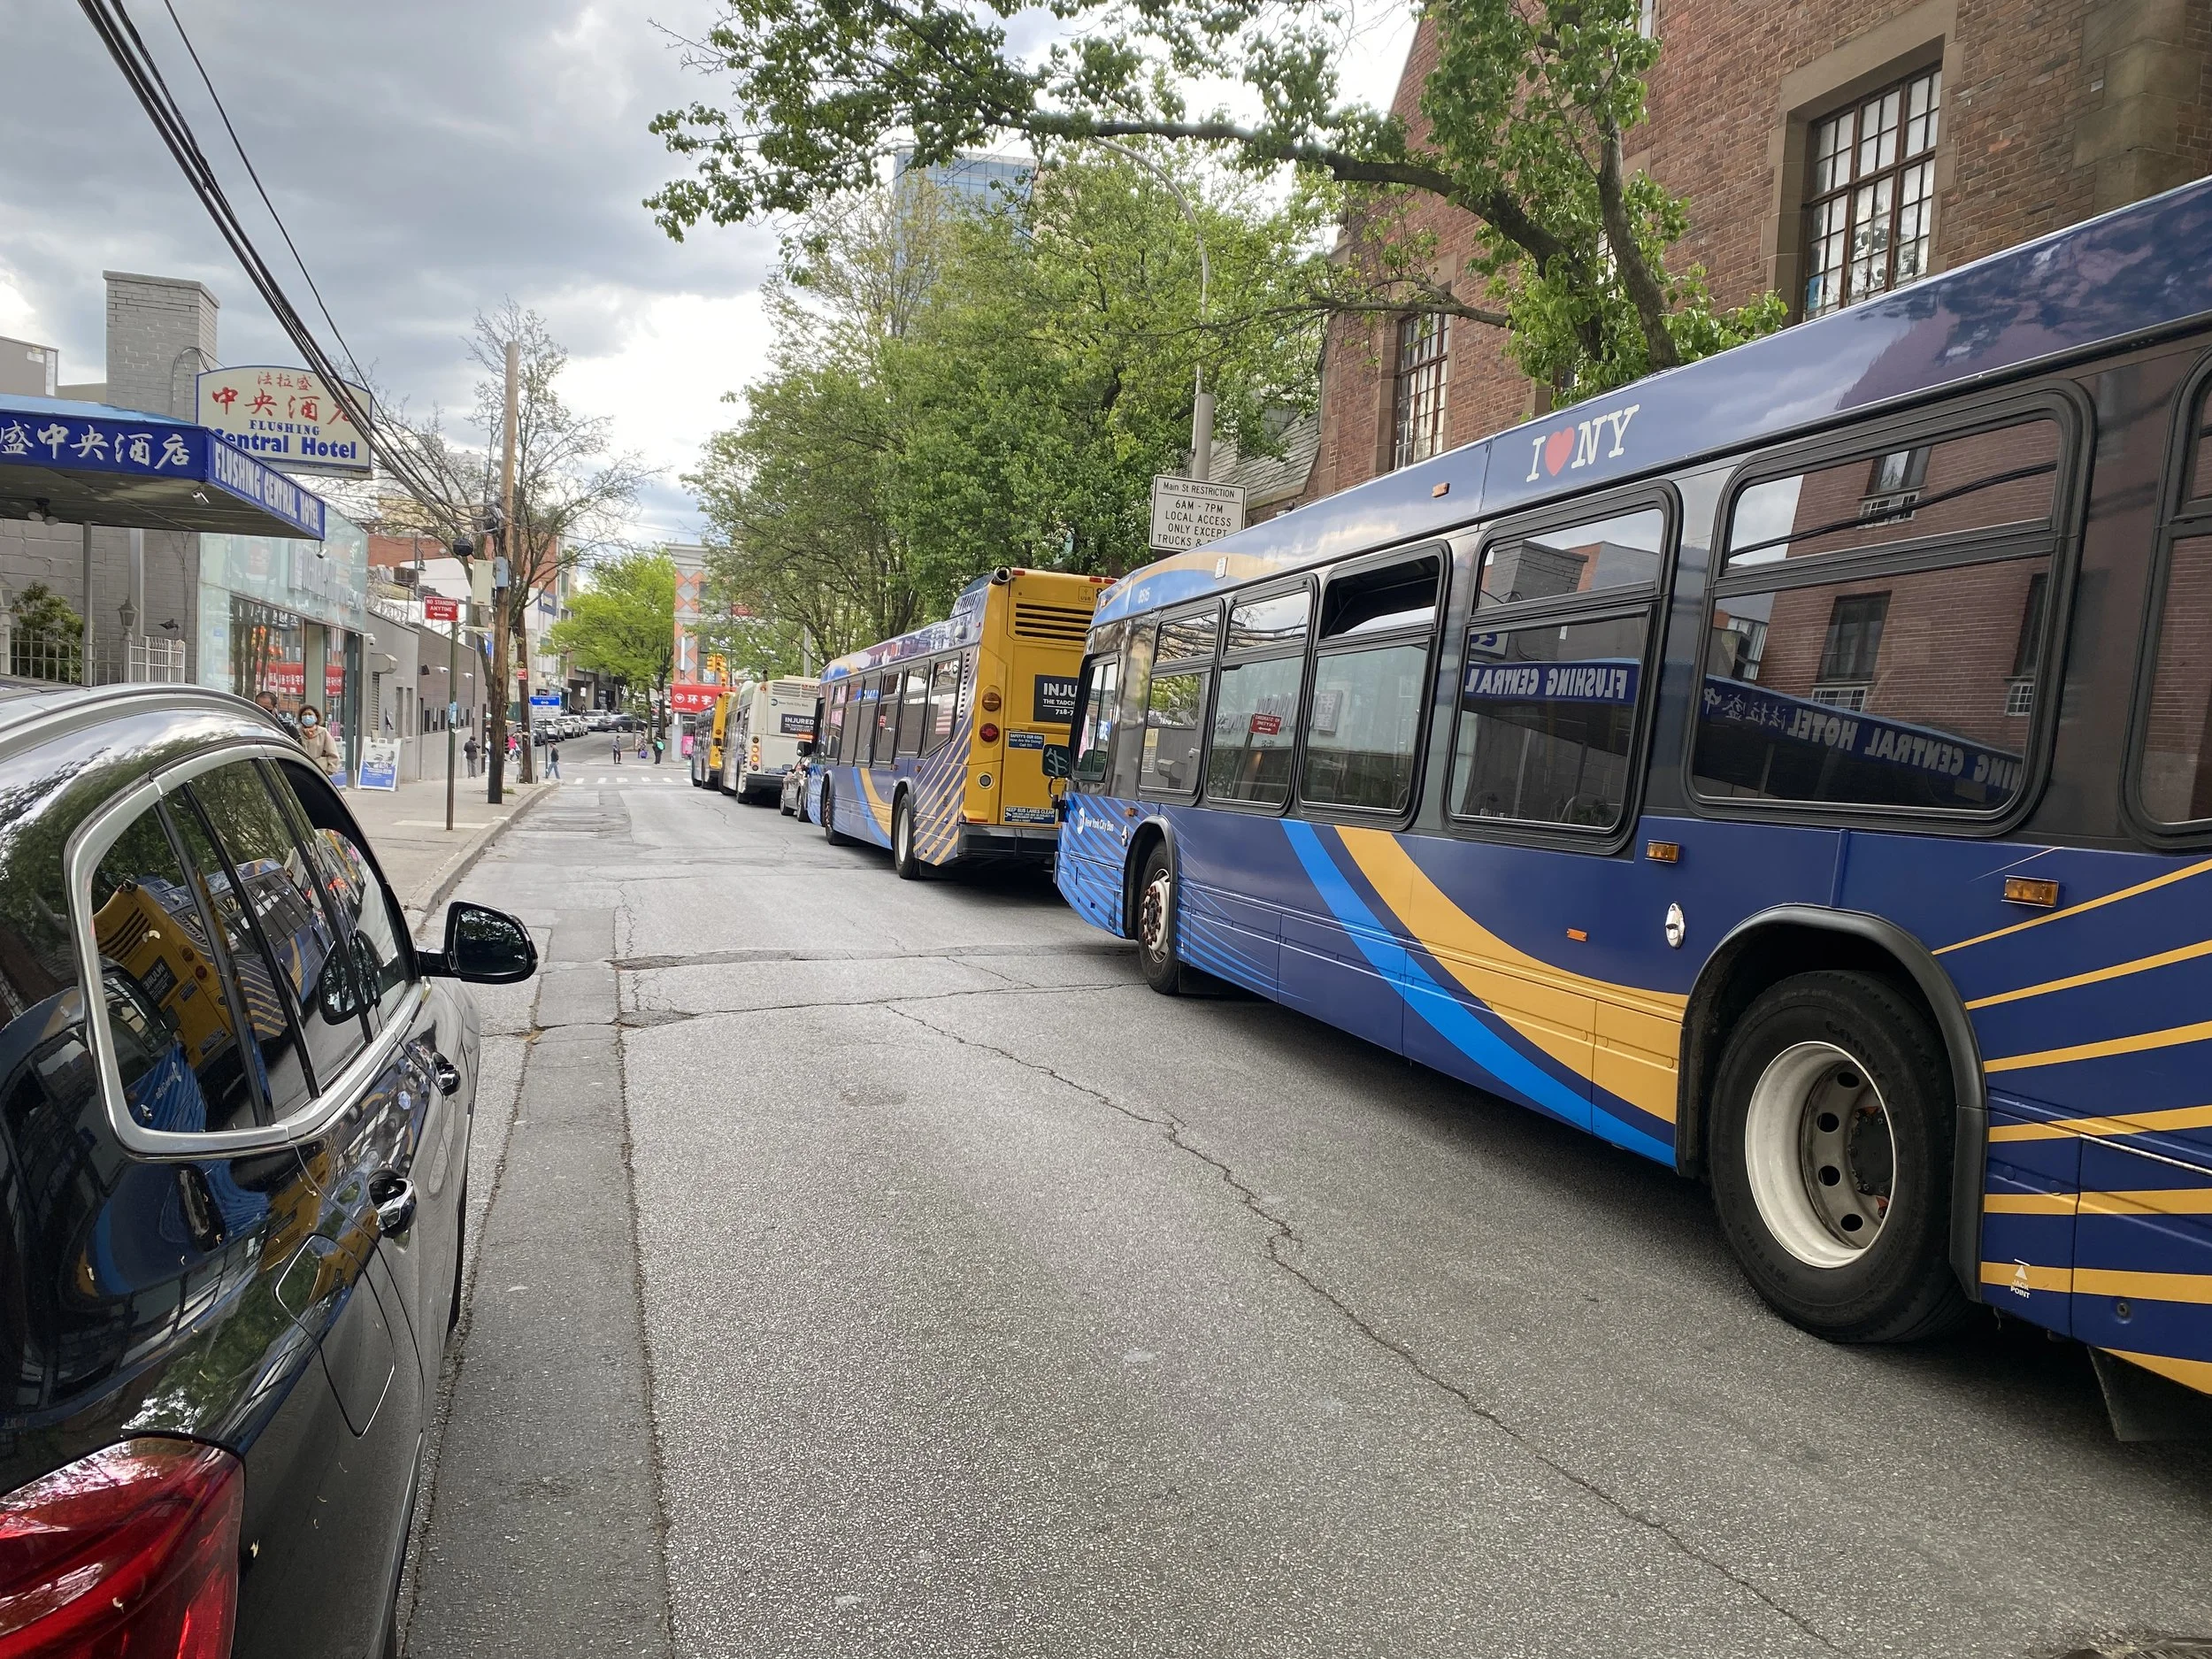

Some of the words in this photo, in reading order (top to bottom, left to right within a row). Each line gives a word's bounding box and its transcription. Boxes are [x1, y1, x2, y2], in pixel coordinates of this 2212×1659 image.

[257, 372, 312, 391] 法拉盛
[249, 419, 320, 436] FLUSHING
[0, 419, 190, 470] 盛中央酒店
[302, 436, 357, 460] Hotel
[1526, 435, 1547, 482] I
[1571, 403, 1640, 469] NY
[215, 442, 261, 500] FLUSHING
[264, 472, 297, 519] CENTRAL
[300, 492, 319, 531] HOTEL
[1163, 481, 1179, 491] Main
[1181, 483, 1189, 493] St
[1191, 485, 1234, 498] RESTRICTION
[1175, 499, 1194, 510] 6AM
[1205, 503, 1224, 513] 7PM
[1165, 511, 1194, 522] LOCAL
[1197, 514, 1232, 527] ACCESS
[1168, 523, 1190, 534] ONLY
[1194, 526, 1227, 538] EXCEPT
[1157, 534, 1192, 547] TRUCKS
[1195, 539, 1202, 548] &
[785, 717, 814, 726] INJURED
[2010, 1286, 2031, 1299] POINT
[2011, 1279, 2029, 1291] JACK
